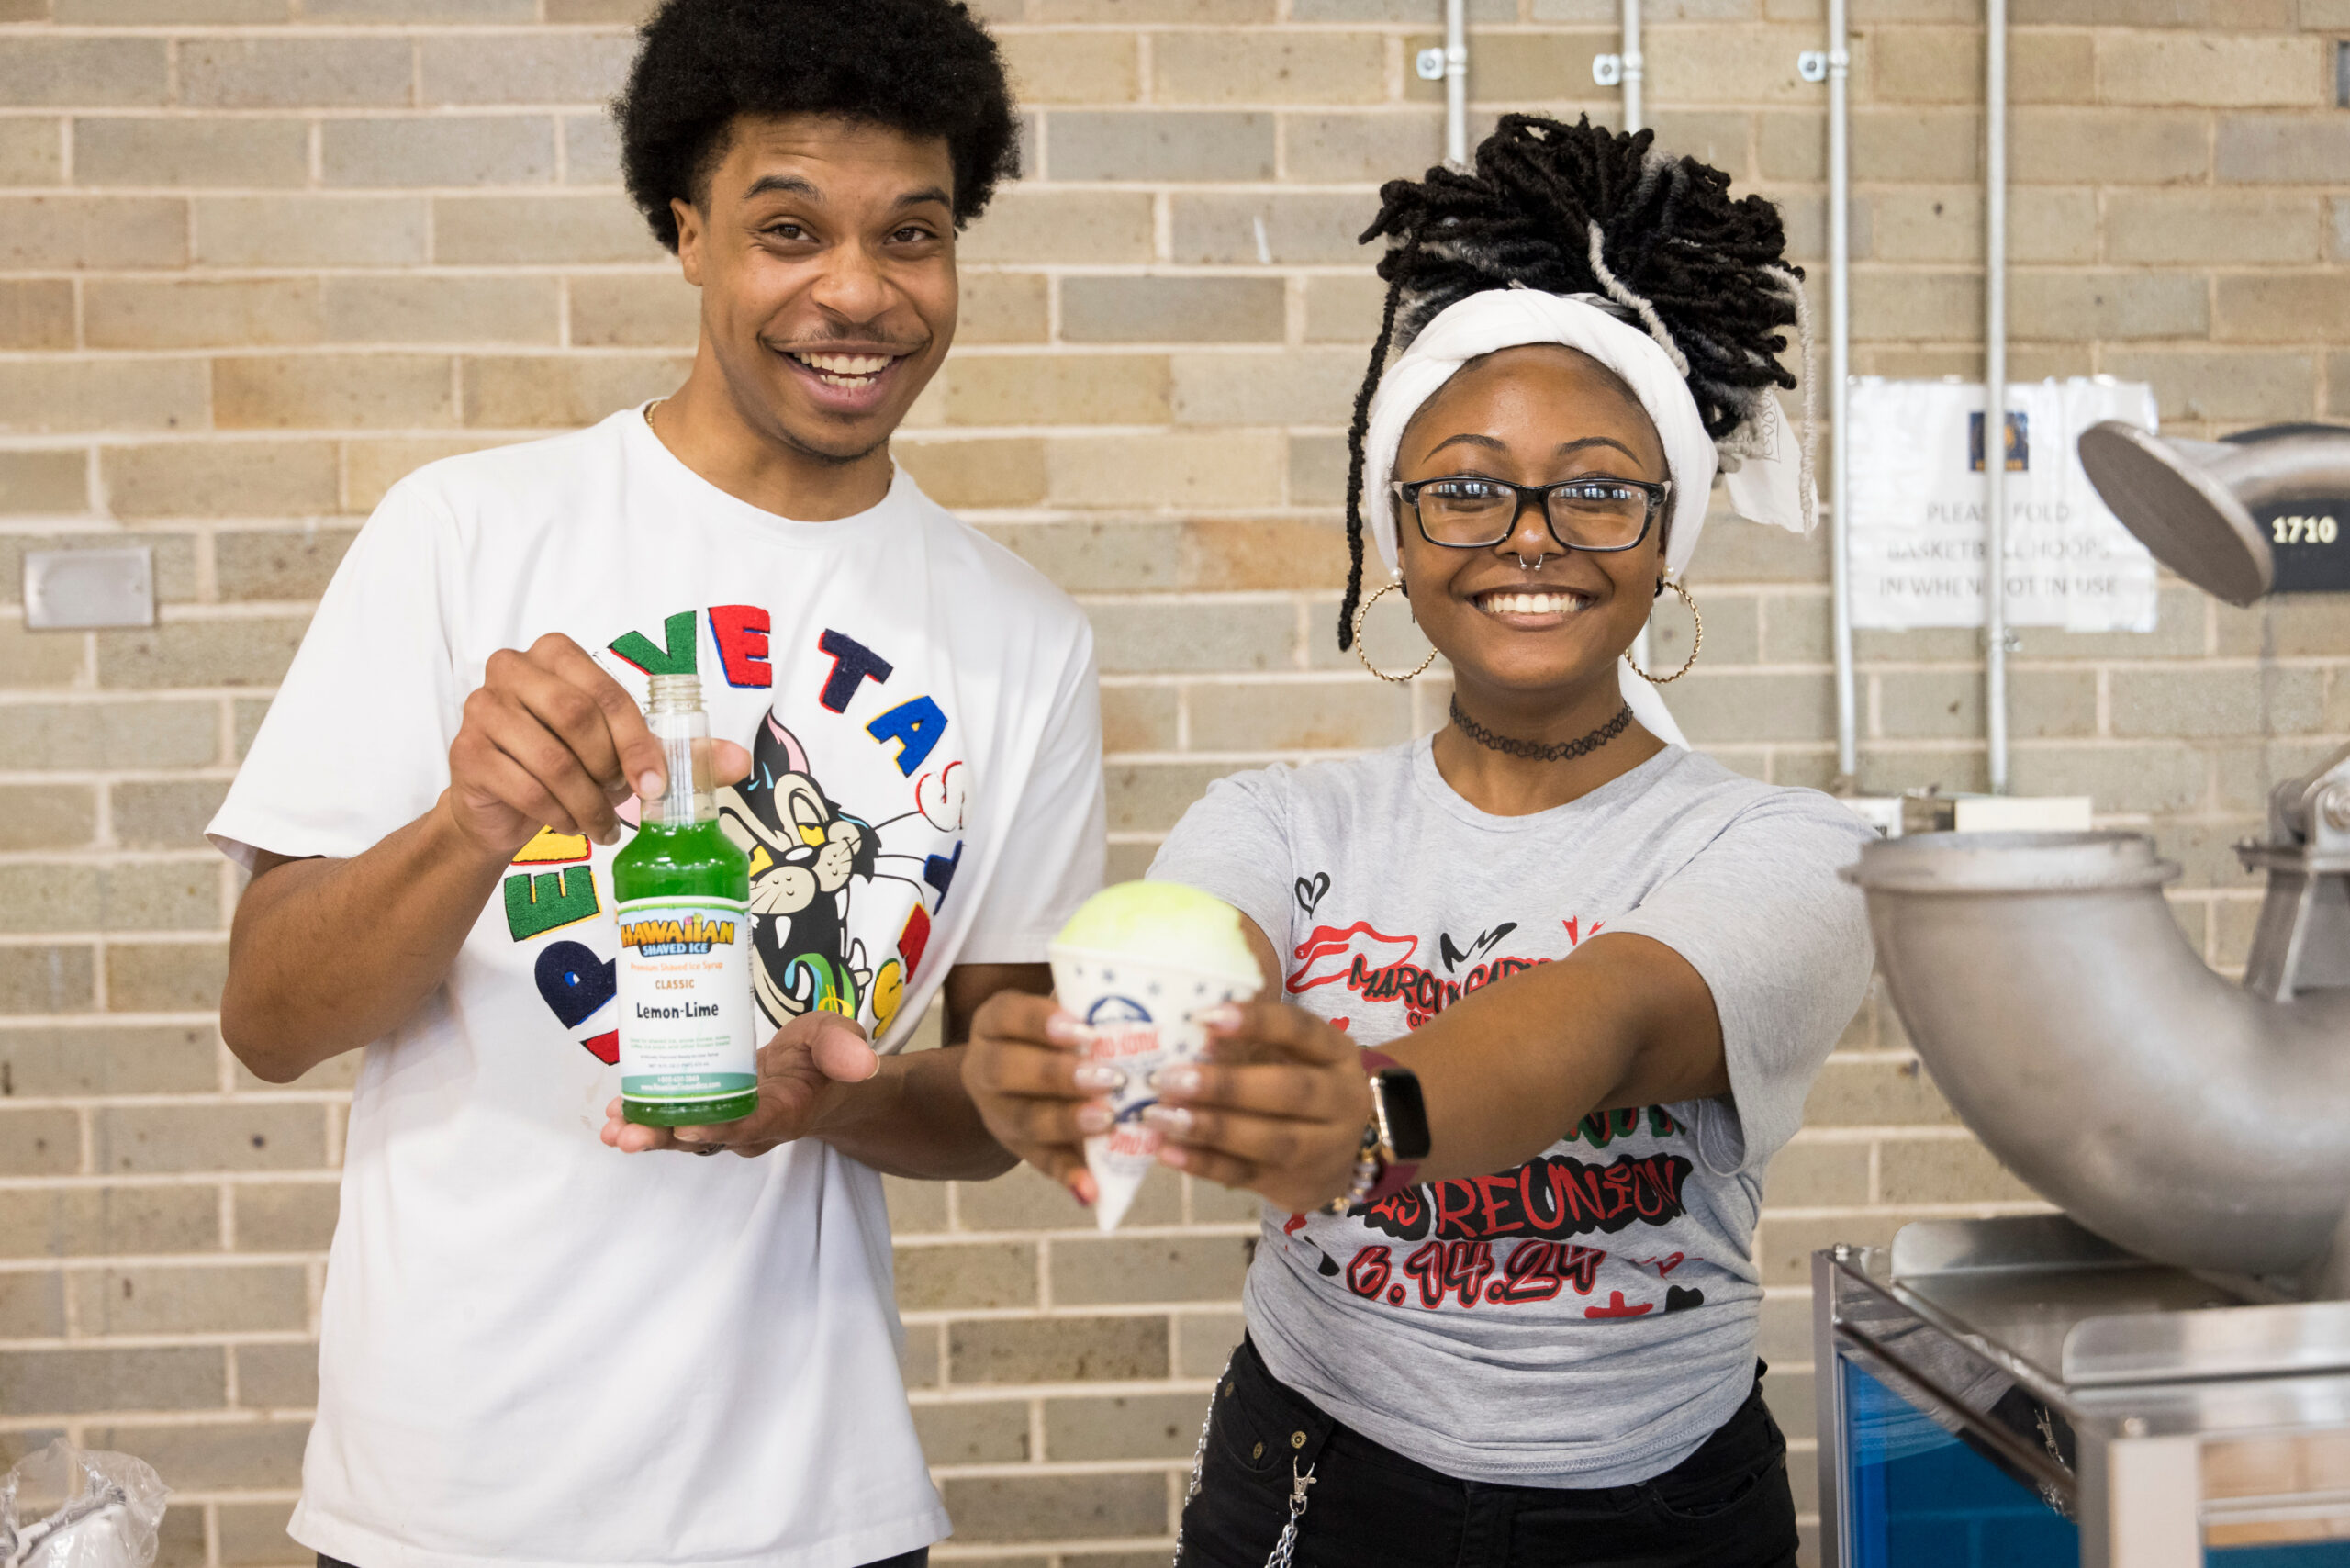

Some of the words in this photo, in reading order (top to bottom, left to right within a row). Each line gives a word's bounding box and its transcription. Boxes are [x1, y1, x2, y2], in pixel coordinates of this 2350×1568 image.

[2272, 515, 2338, 544] 1710
[1880, 576, 1902, 597] IN
[2006, 576, 2034, 597] OT
[2045, 577, 2067, 597] IN
[2076, 576, 2118, 597] USE
[621, 914, 735, 947] HAWAIIAN
[643, 943, 686, 957] SHAVED
[689, 942, 708, 954] ICE
[661, 962, 688, 971] Shaved
[689, 961, 700, 970] Ice
[702, 960, 723, 971] Syrup
[655, 979, 695, 990] CLASSIC
[636, 1002, 719, 1019] Lemon-Lime
[1346, 1239, 1607, 1310] 6.14.24
